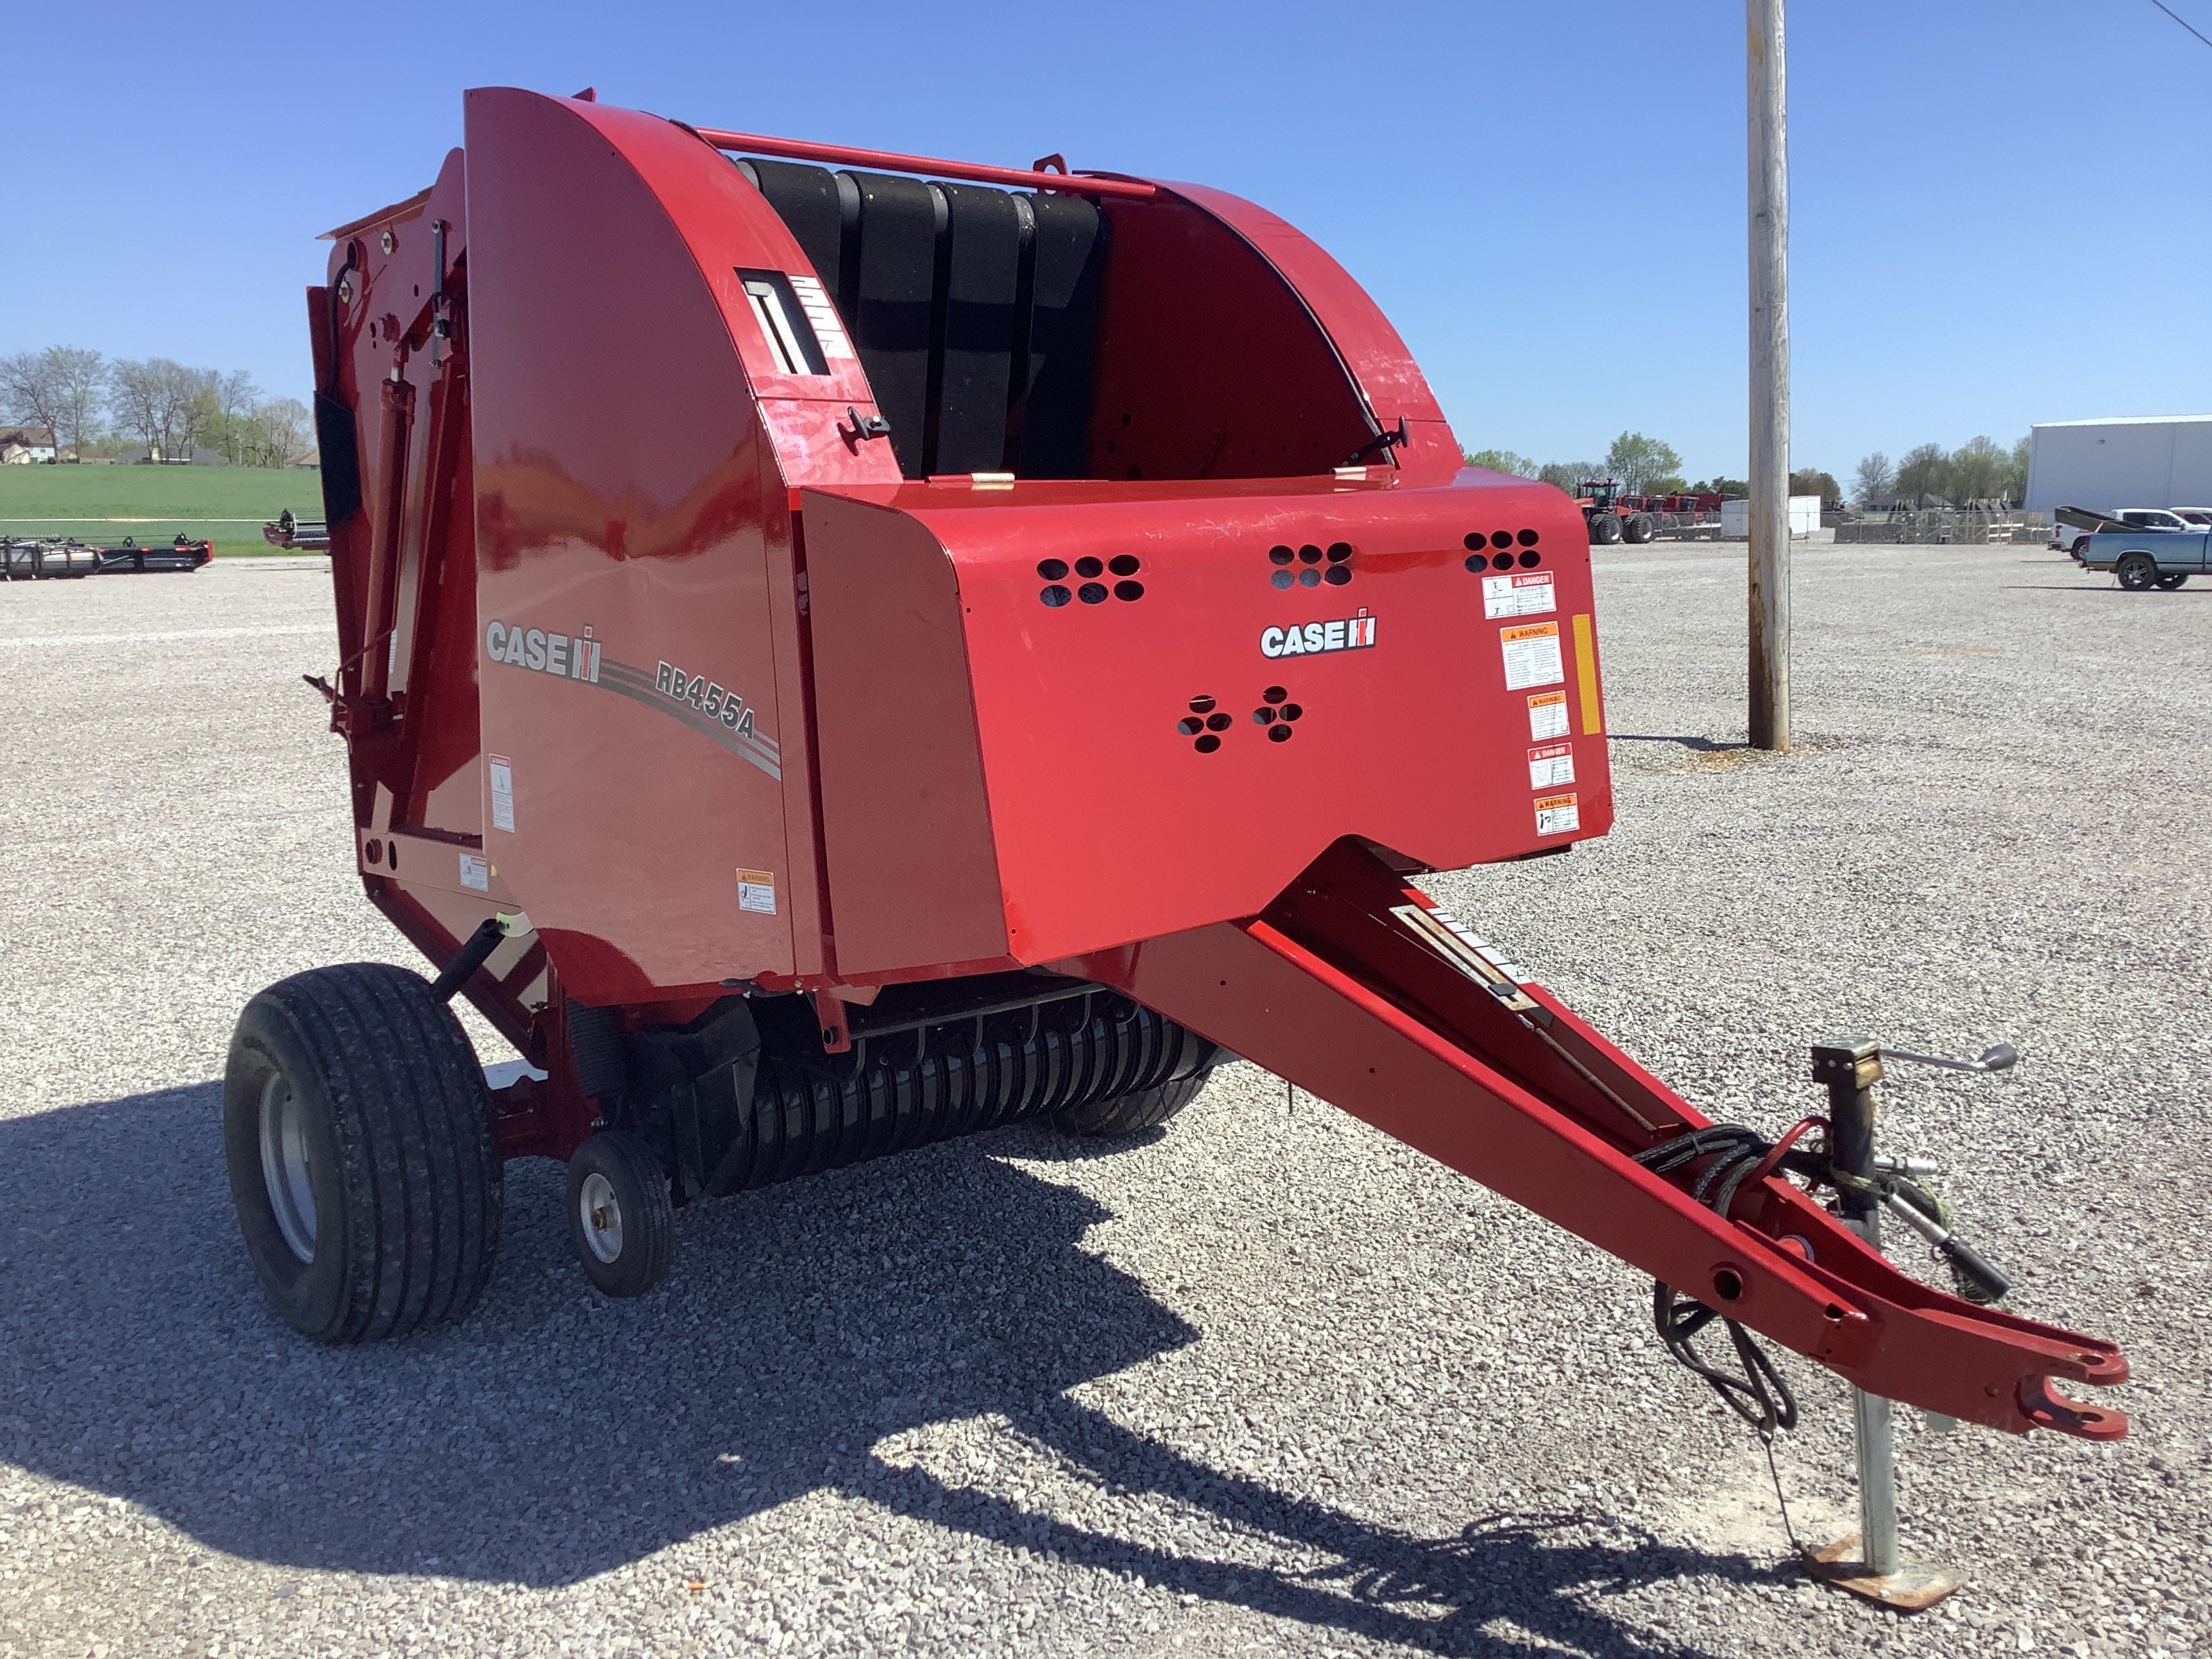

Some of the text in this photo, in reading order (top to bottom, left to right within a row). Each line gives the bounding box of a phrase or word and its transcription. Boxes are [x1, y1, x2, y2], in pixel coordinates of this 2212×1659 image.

[1523, 575, 1549, 586] DANGER
[1261, 620, 1345, 658] CASE
[1519, 627, 1548, 638] WARNING
[486, 621, 568, 676] CASE
[655, 659, 754, 741] RB455A
[1544, 796, 1572, 807] WARNING
